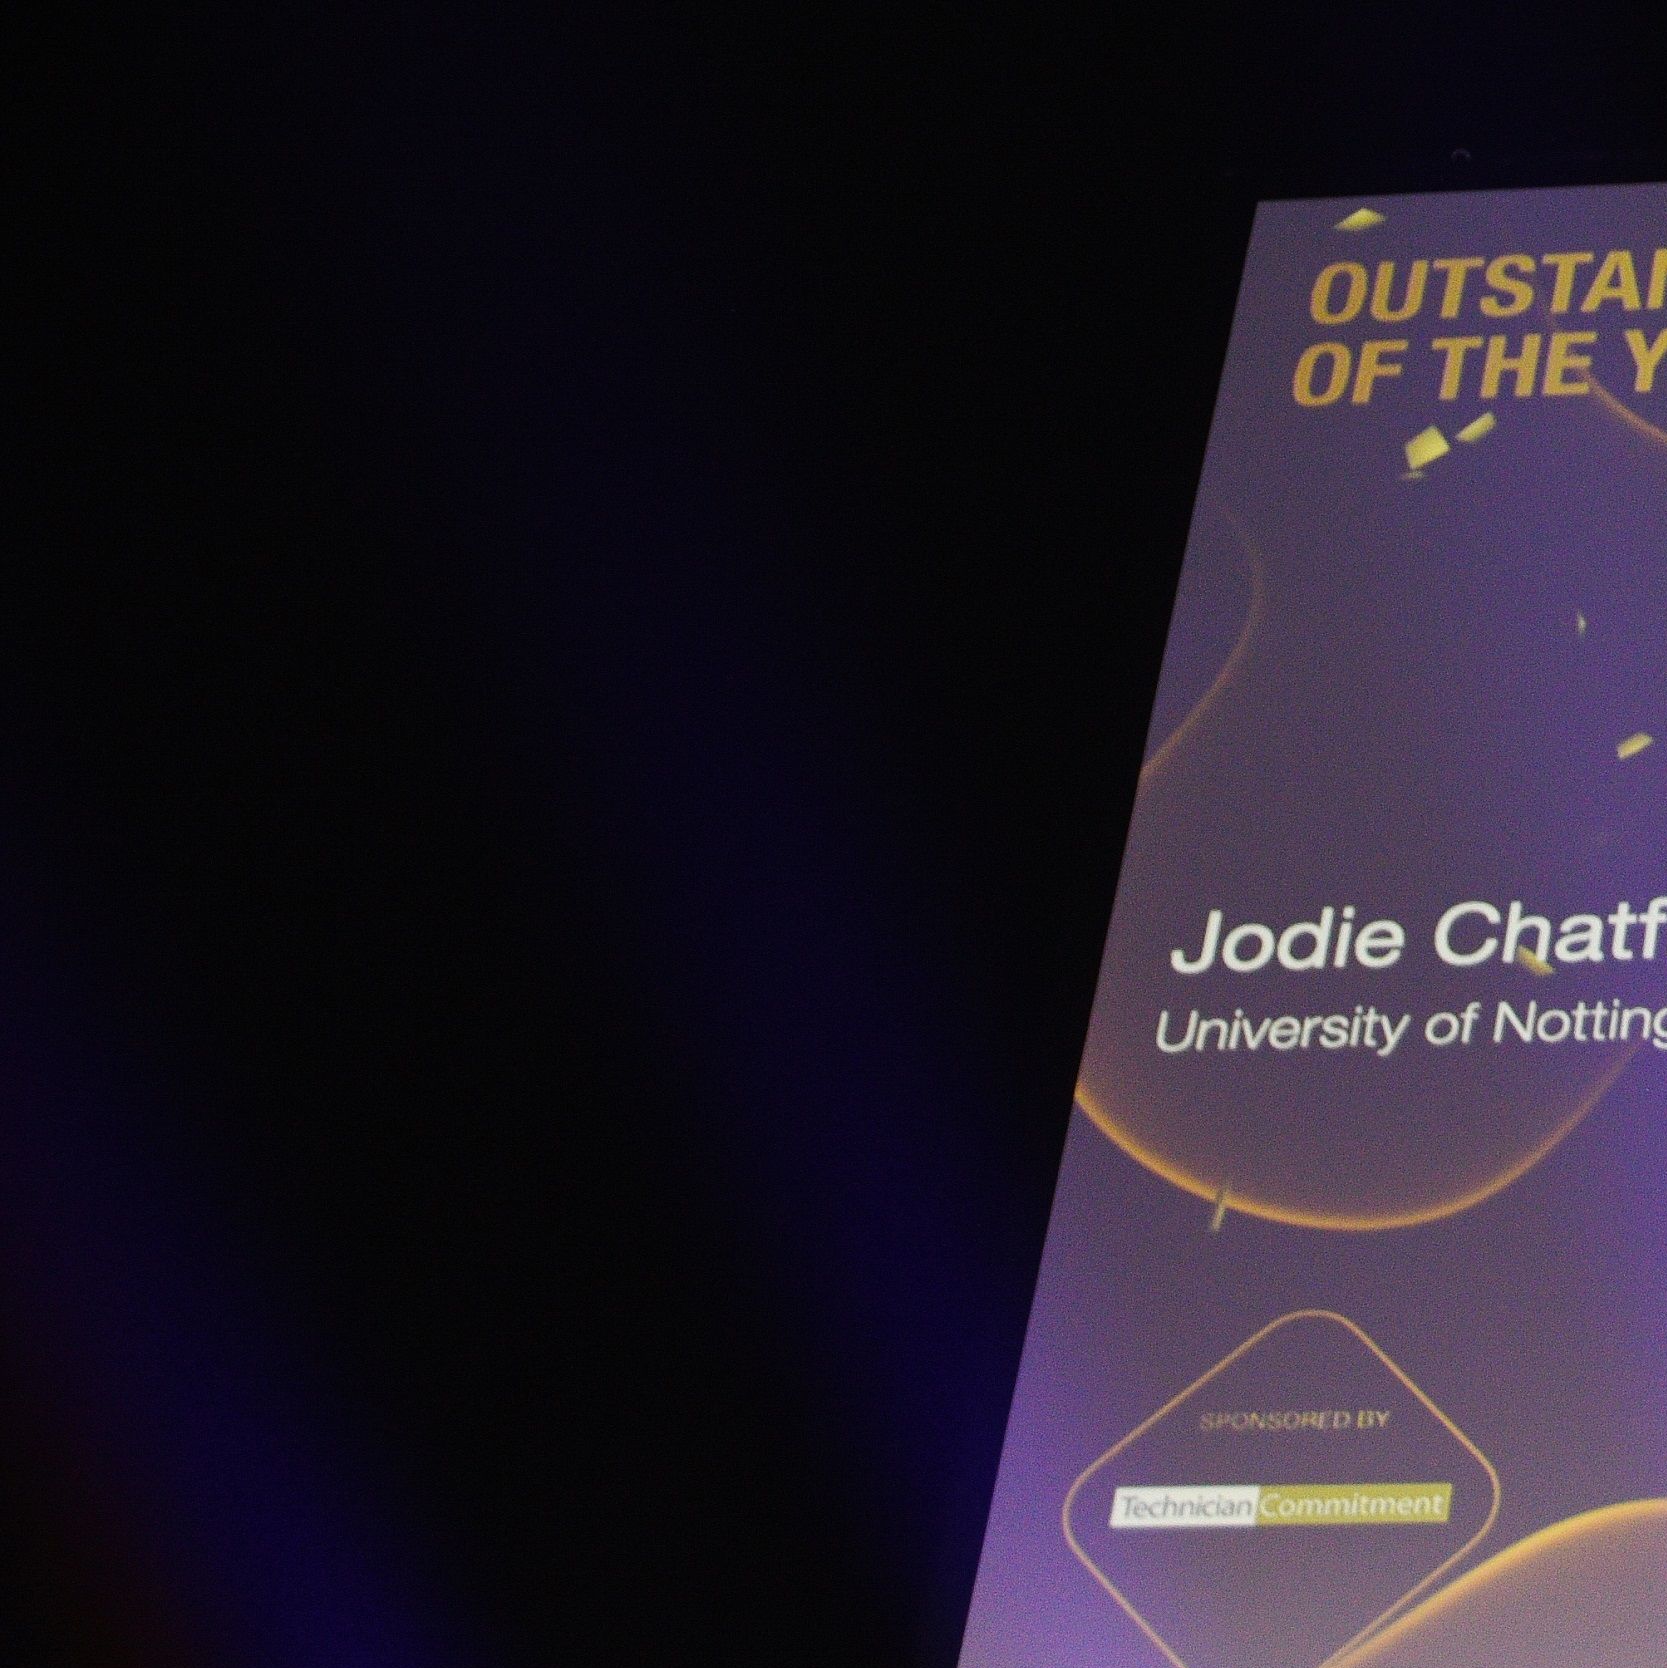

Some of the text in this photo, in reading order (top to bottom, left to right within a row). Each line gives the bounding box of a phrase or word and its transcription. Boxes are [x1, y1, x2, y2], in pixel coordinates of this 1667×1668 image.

[1290, 337, 1408, 408] OF
[1430, 328, 1597, 400] THE
[1170, 906, 1406, 975] Jodie
[1155, 1002, 1411, 1057] University
[1424, 1002, 1481, 1045] of
[1200, 1409, 1391, 1432] SPONSORED BY
[1119, 1491, 1444, 1520] Technician Commitment
